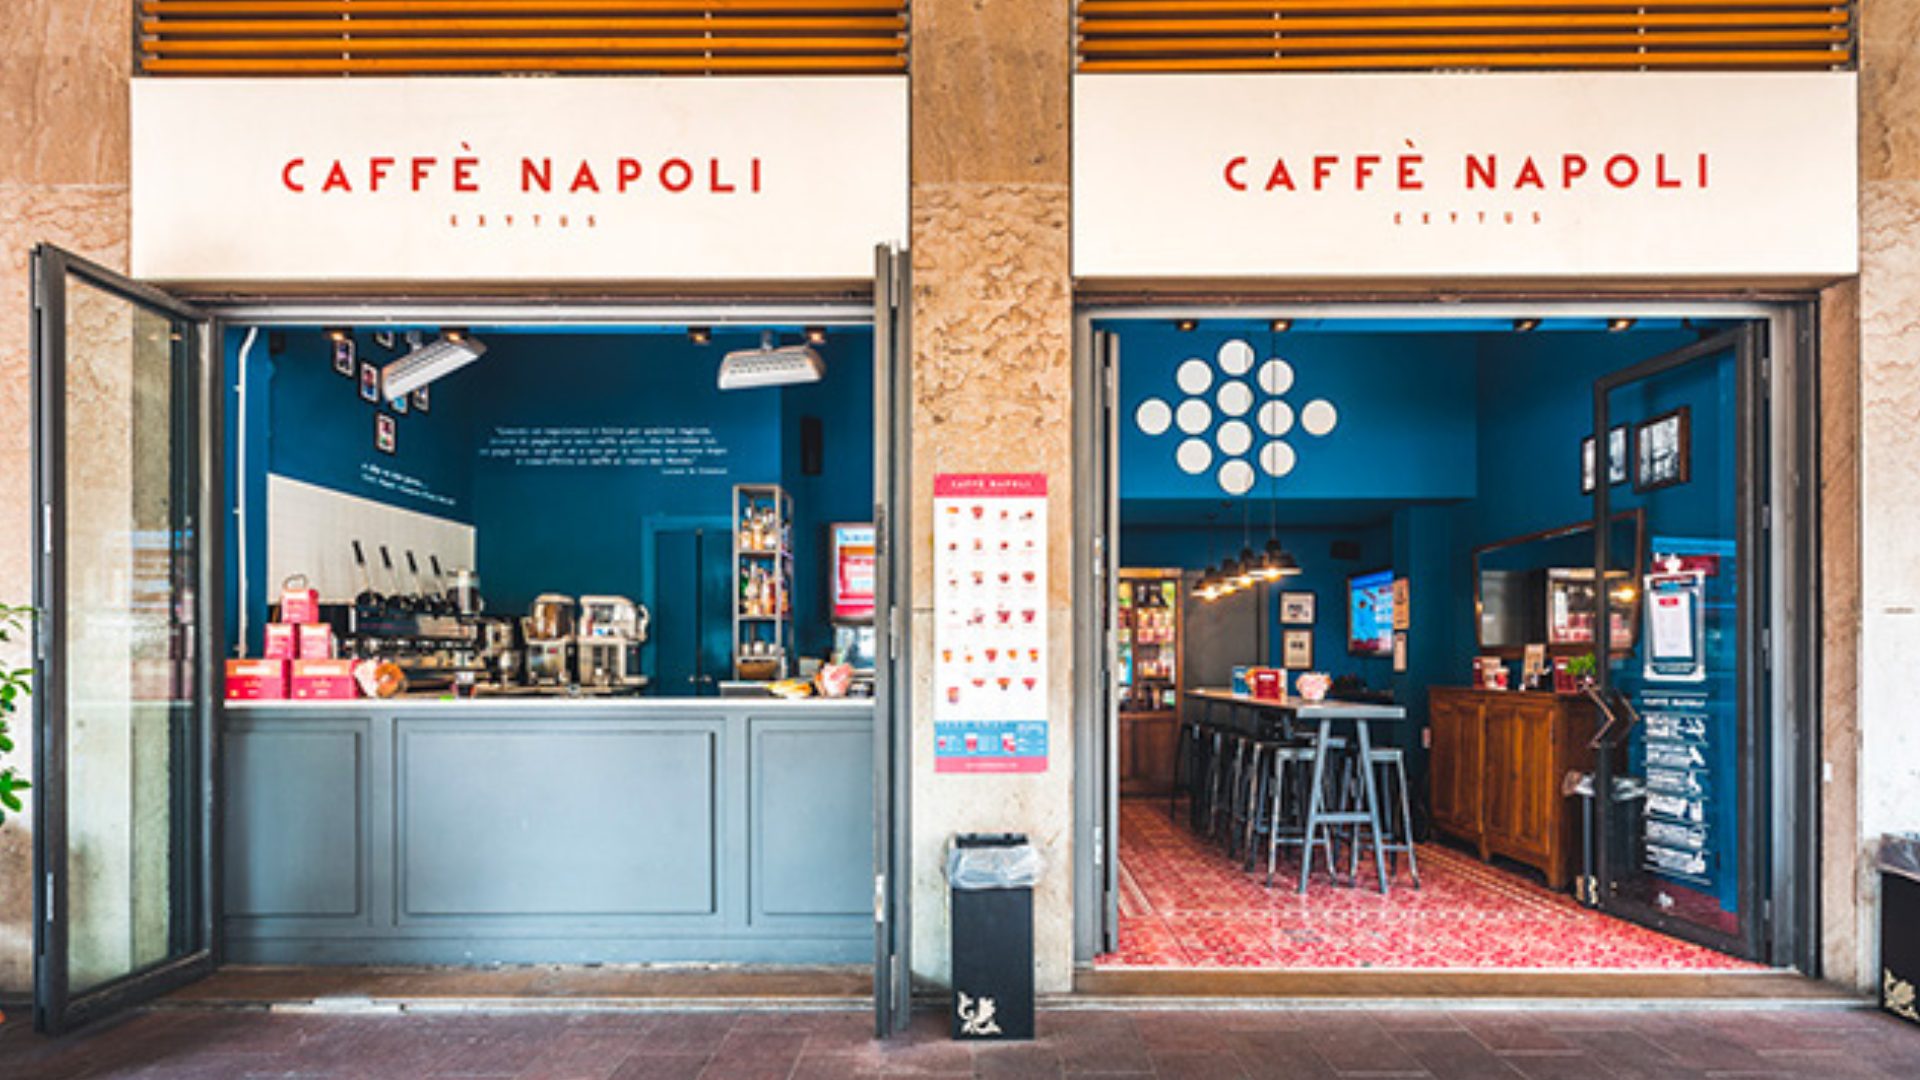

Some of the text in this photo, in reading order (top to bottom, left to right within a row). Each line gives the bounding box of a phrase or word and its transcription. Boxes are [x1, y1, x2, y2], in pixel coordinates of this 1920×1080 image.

[281, 142, 762, 194] CAFFÈ NAPOLI
[1223, 139, 1708, 191] CAFFÈ NAPOLI
